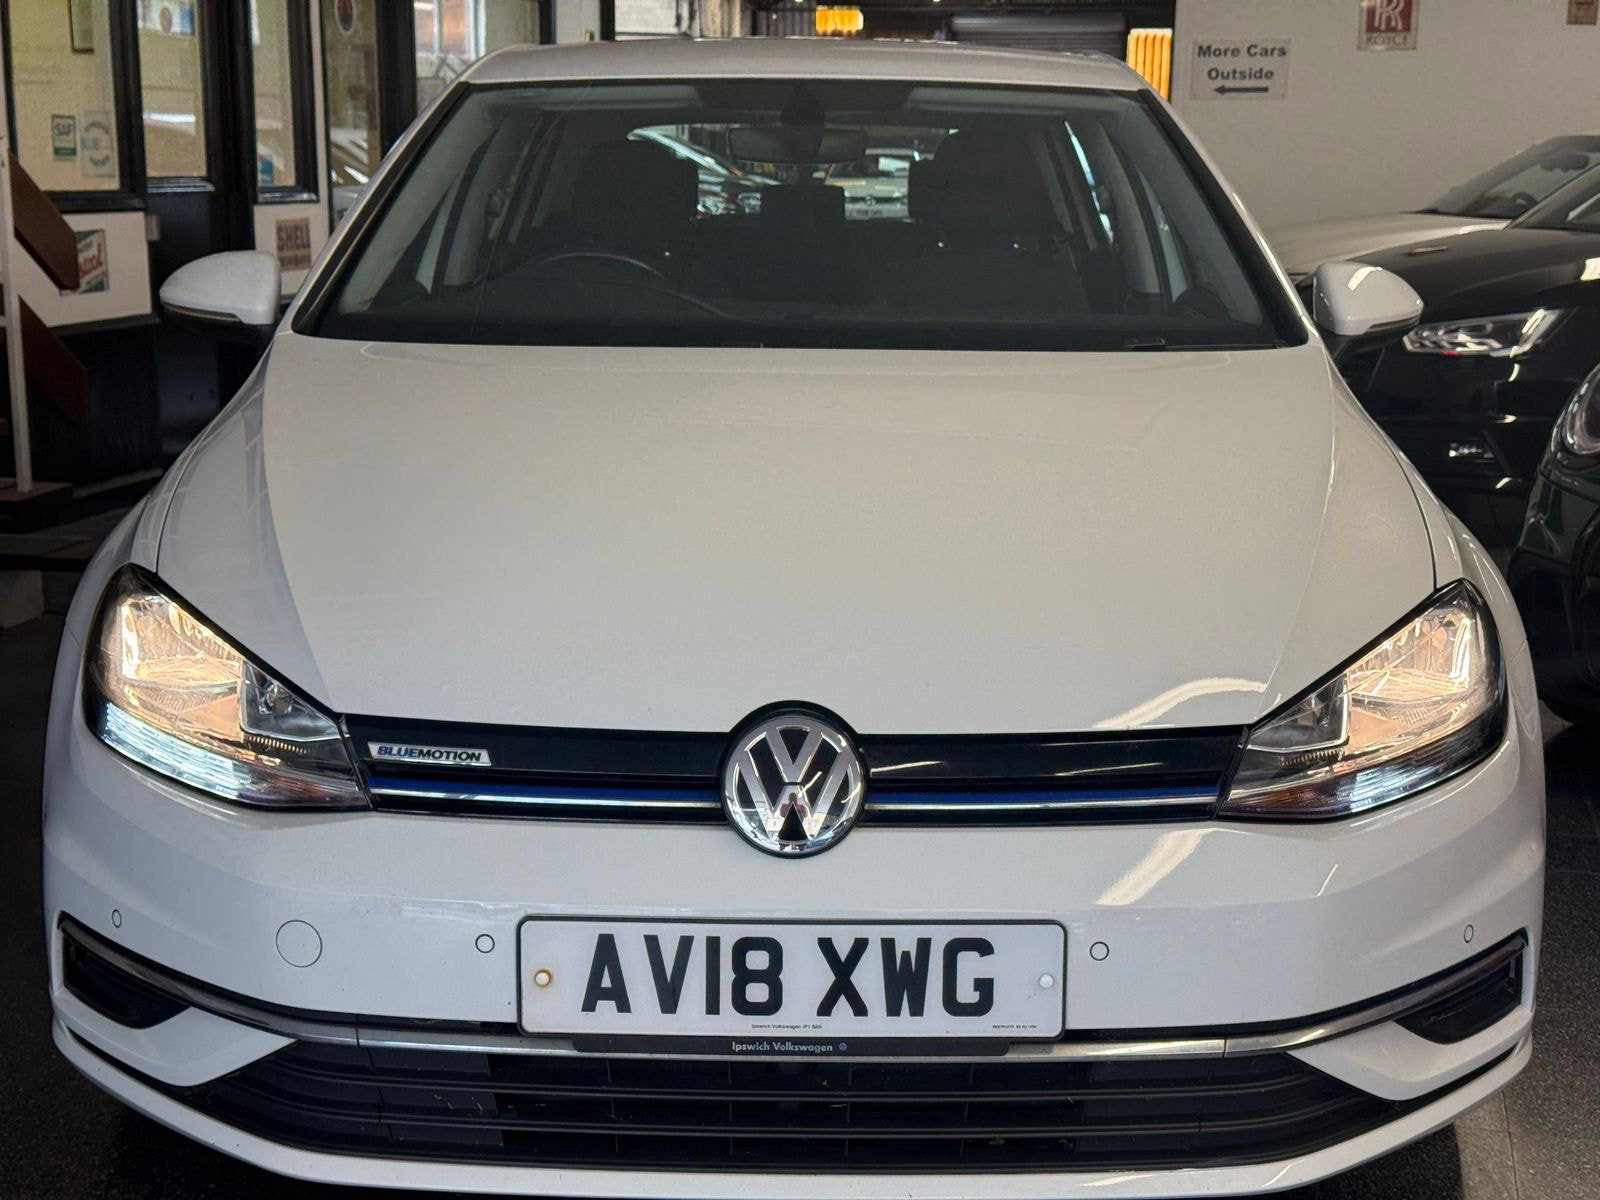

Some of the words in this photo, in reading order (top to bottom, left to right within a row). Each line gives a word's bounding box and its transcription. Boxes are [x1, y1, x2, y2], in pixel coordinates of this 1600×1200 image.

[1198, 45, 1240, 57] More
[1247, 44, 1287, 57] Cars
[1208, 67, 1274, 80] Outside
[277, 224, 310, 251] SHELL
[377, 745, 481, 762] BLUEMOTION
[581, 933, 783, 1016] AV18
[816, 937, 995, 1017] XWG
[732, 1041, 770, 1052] Ipswich
[772, 1041, 833, 1053] Volkswagen
